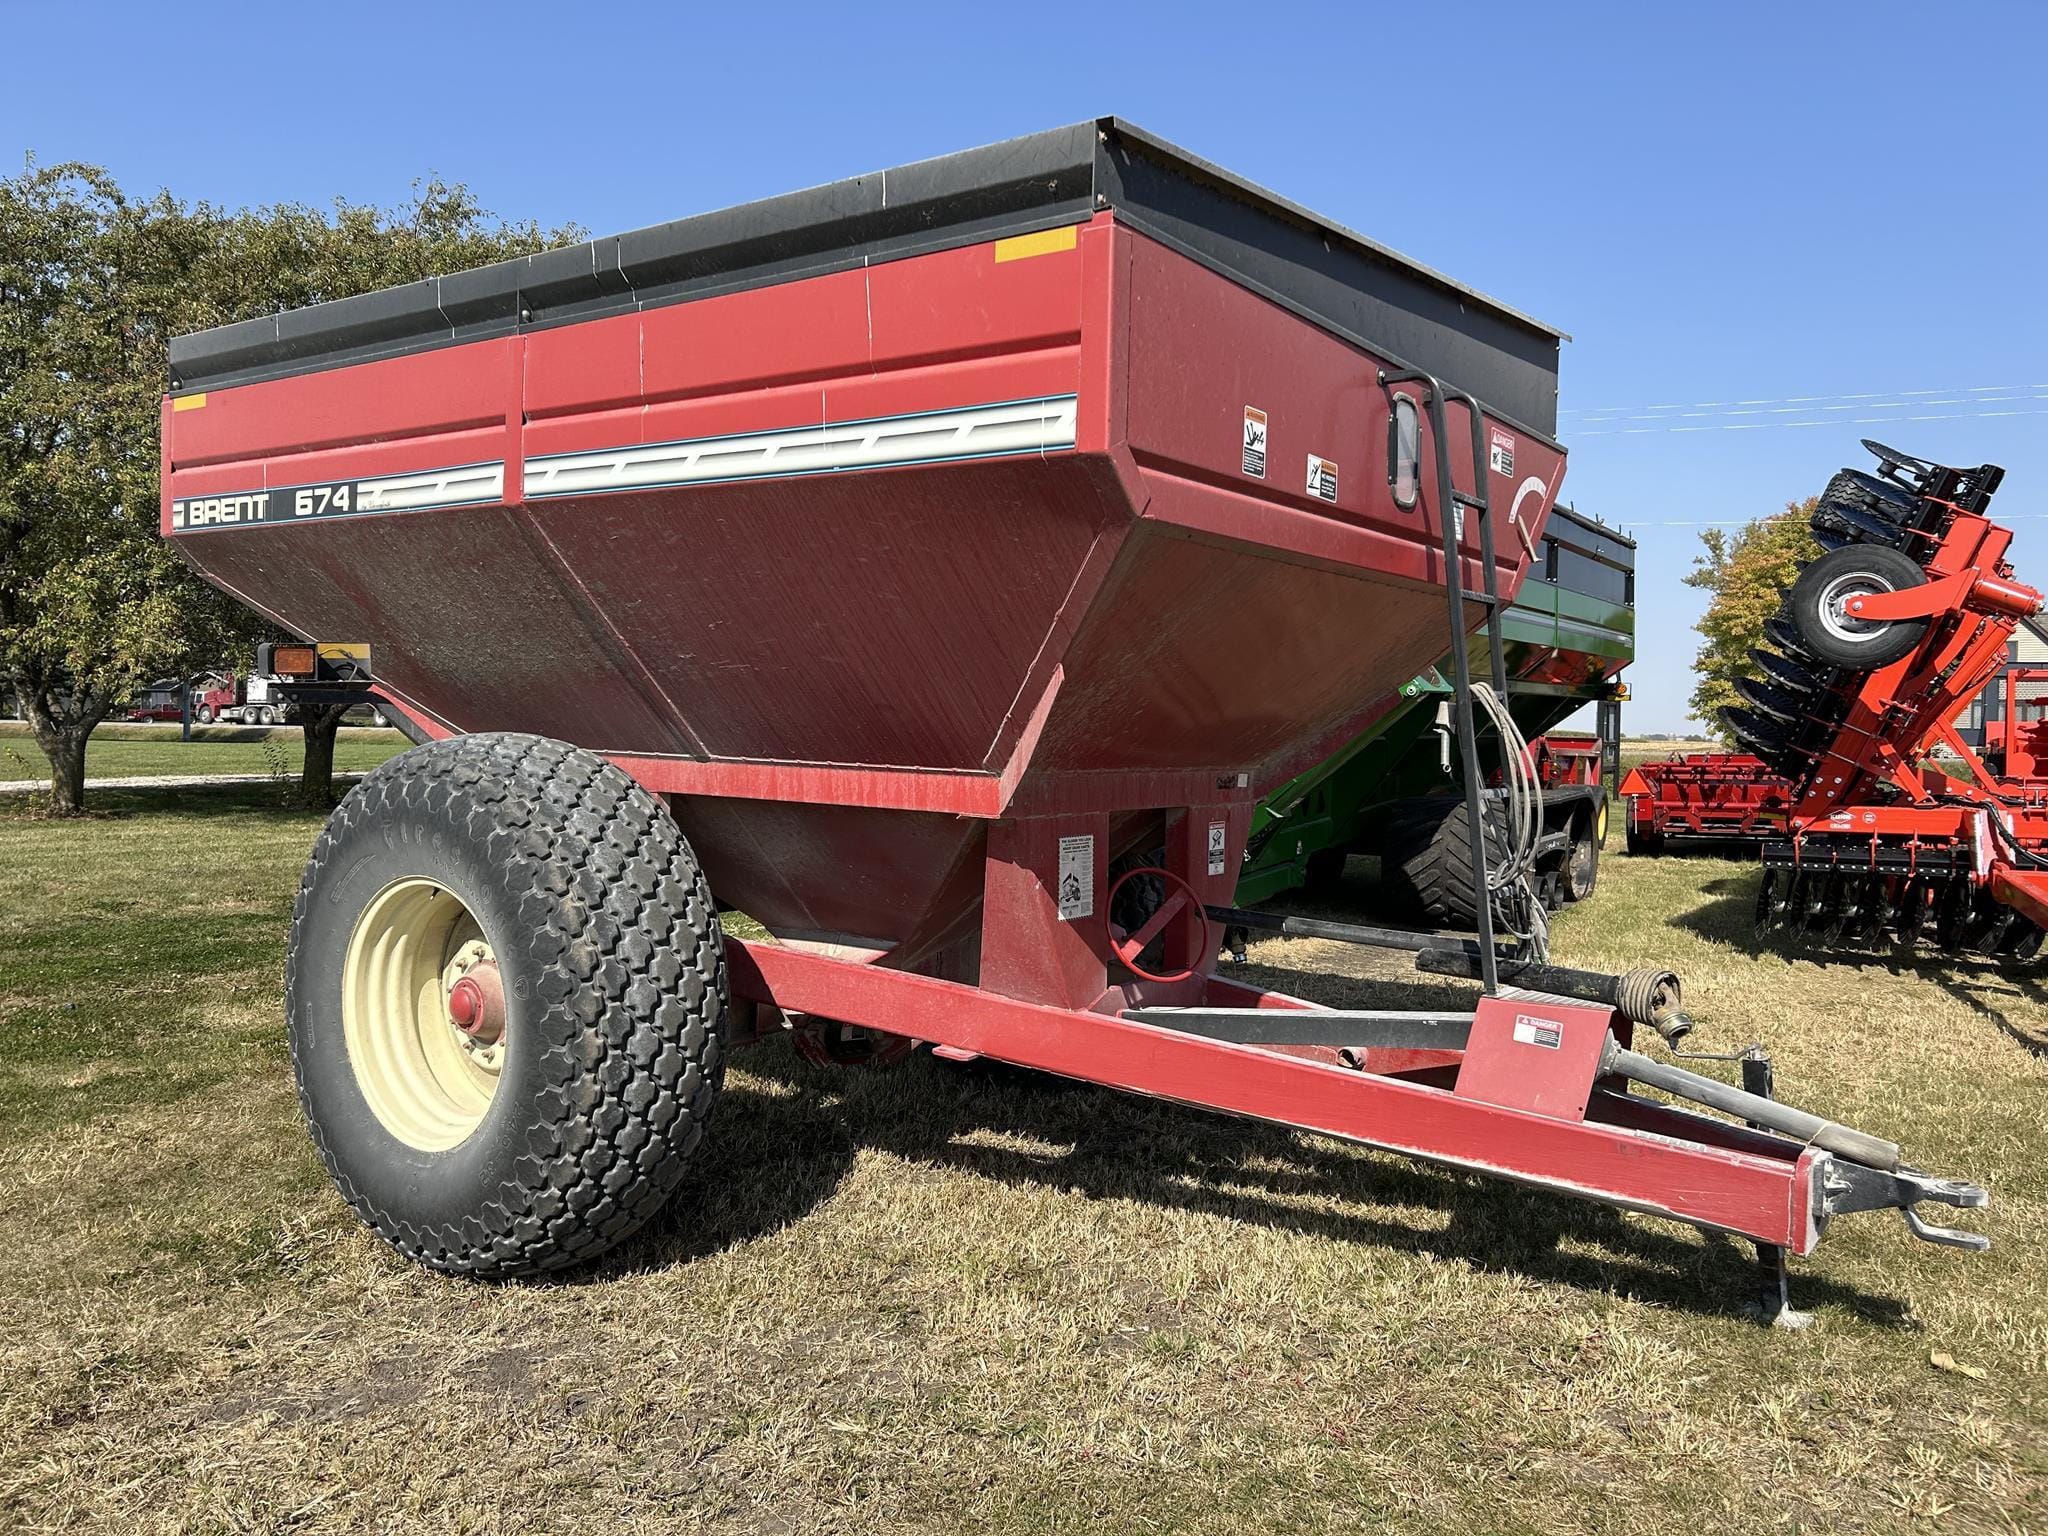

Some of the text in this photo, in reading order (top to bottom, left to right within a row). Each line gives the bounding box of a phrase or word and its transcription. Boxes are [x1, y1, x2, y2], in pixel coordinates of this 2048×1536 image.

[190, 486, 349, 524] BRENT 674
[1530, 1019, 1558, 1029] DANGER
